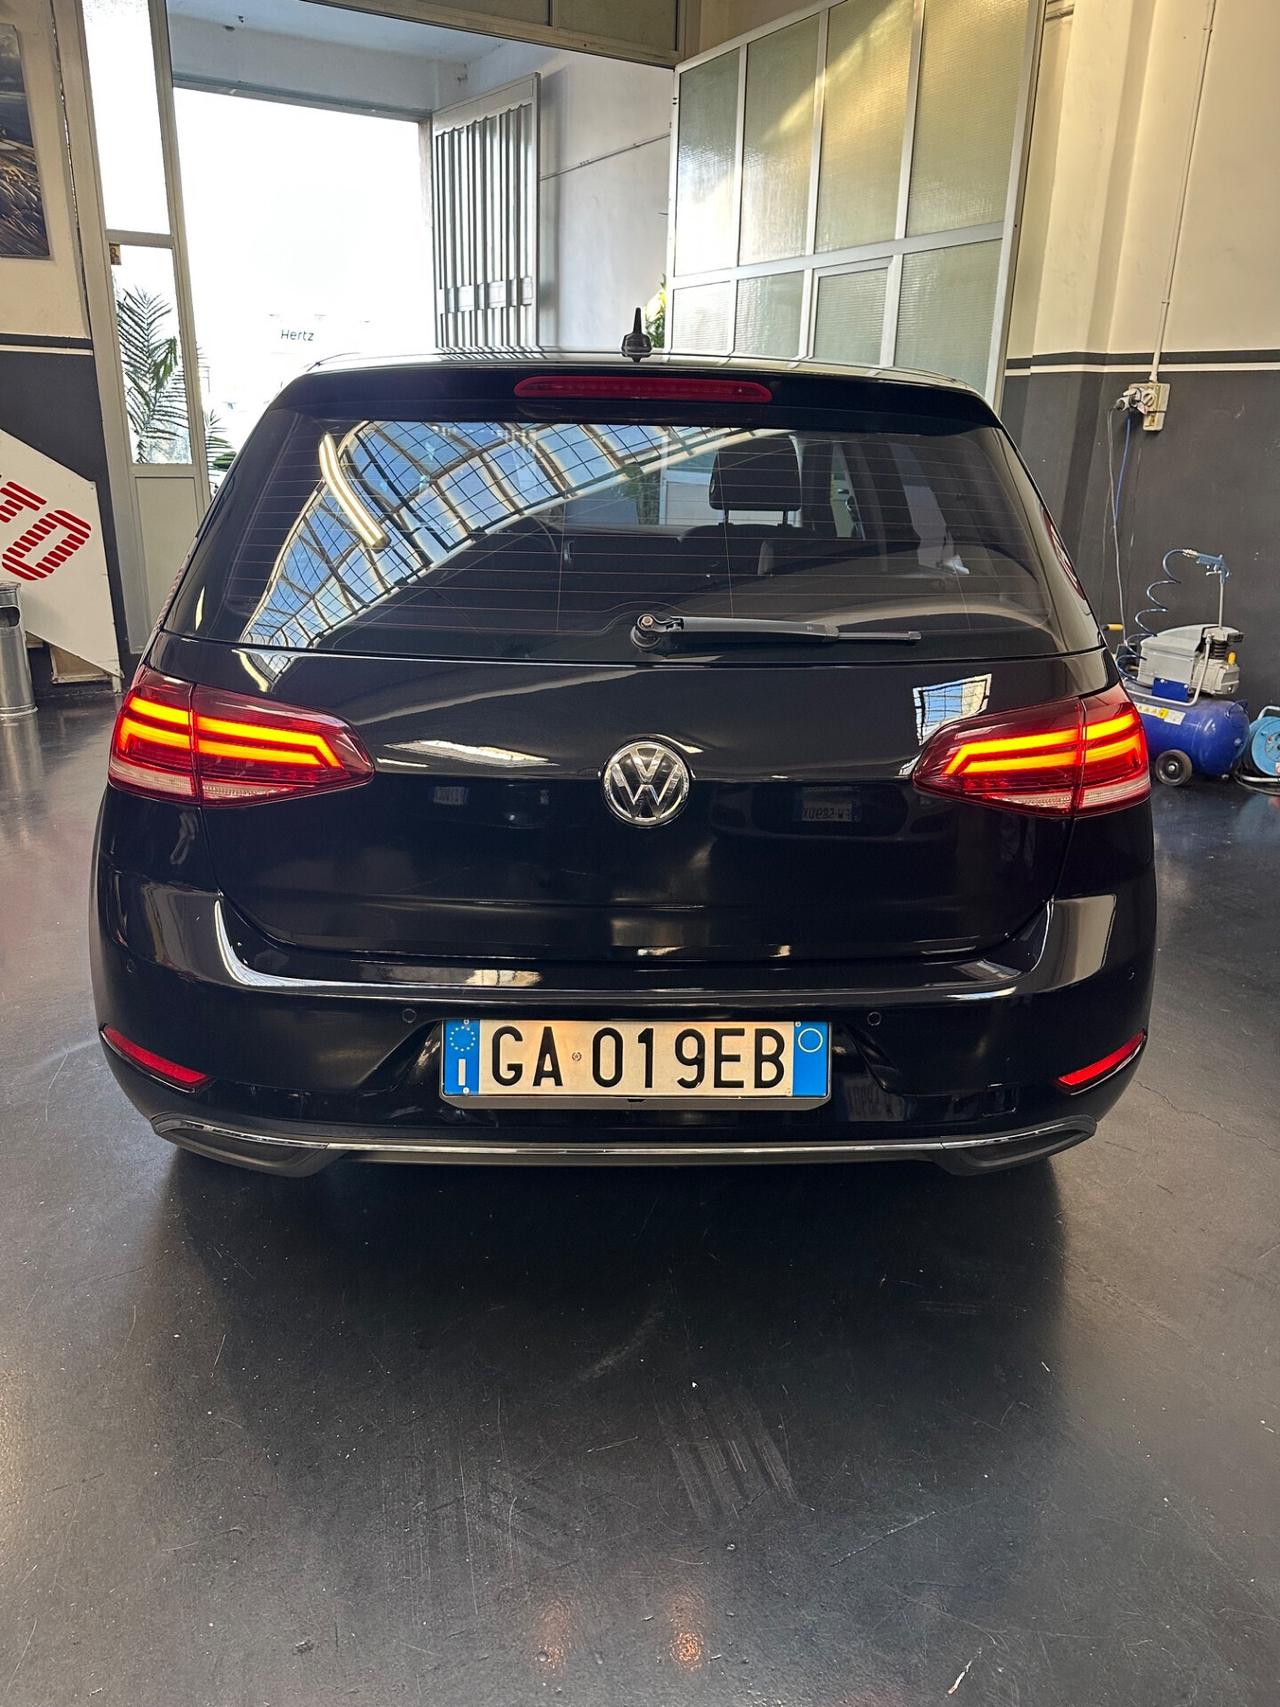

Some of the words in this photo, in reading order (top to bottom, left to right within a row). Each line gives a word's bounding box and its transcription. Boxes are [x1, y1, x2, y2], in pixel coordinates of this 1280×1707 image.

[280, 329, 315, 342] Hertz
[491, 1026, 563, 1087] GA
[592, 1027, 785, 1089] 019EB
